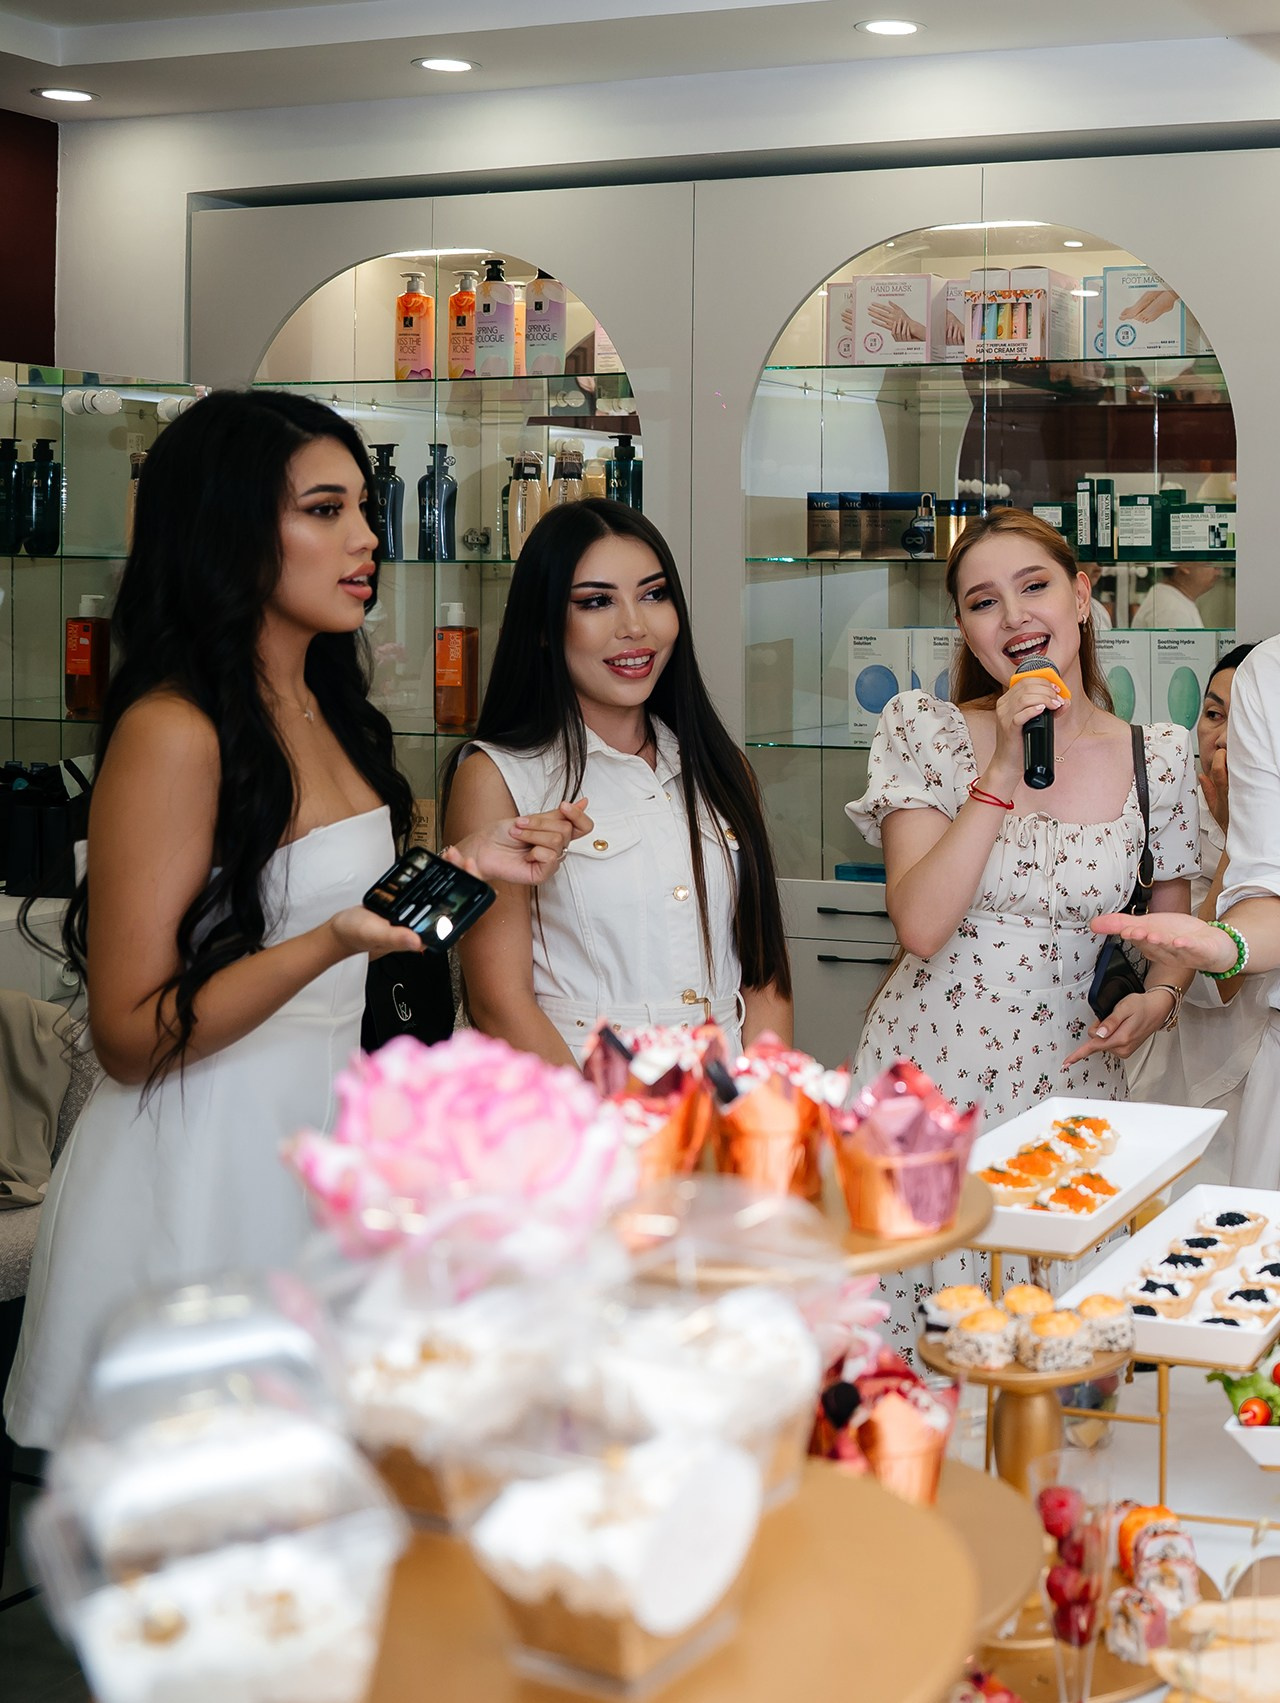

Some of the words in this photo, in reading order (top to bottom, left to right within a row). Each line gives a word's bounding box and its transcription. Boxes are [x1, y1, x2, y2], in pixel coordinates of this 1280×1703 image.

[477, 326, 499, 335] SPRING
[527, 324, 551, 333] SPRING
[409, 338, 421, 346] THE
[452, 345, 470, 354] ROSE
